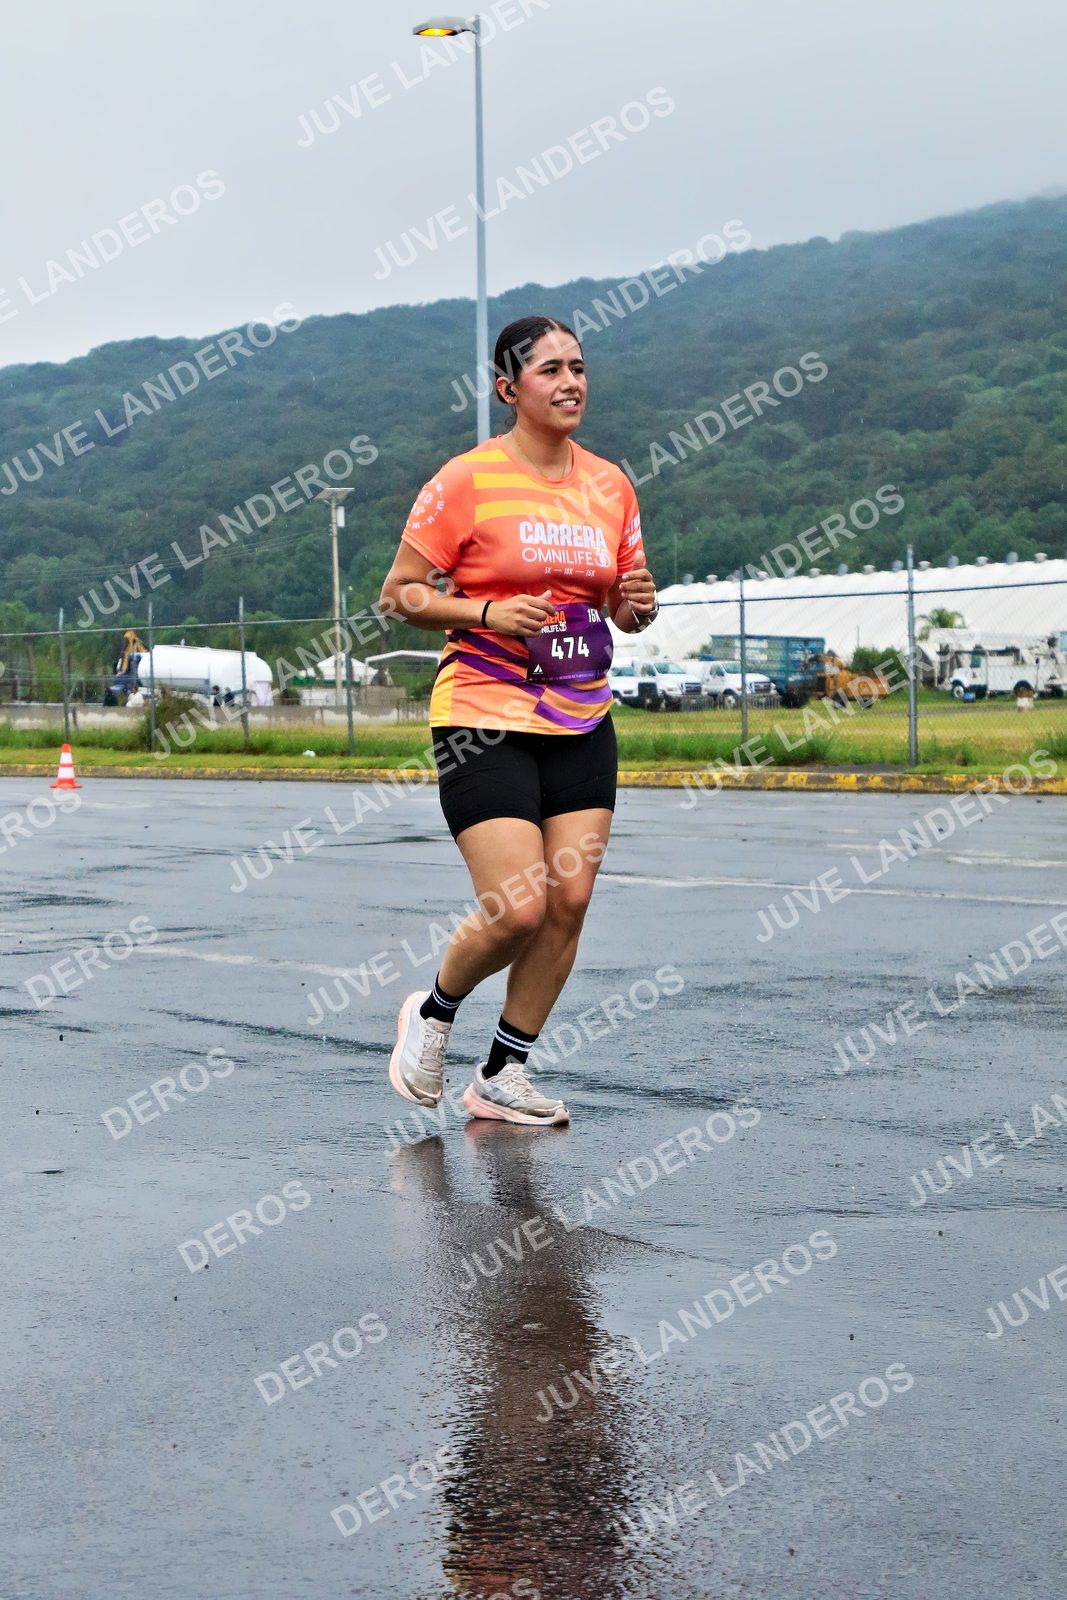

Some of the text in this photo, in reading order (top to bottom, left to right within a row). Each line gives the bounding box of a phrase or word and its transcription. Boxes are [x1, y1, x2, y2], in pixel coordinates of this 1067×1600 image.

[519, 521, 606, 549] CARRERA
[522, 547, 593, 566] OMNILIFE
[587, 608, 602, 623] 15K
[541, 624, 559, 633] NILIFE
[551, 636, 590, 660] 474
